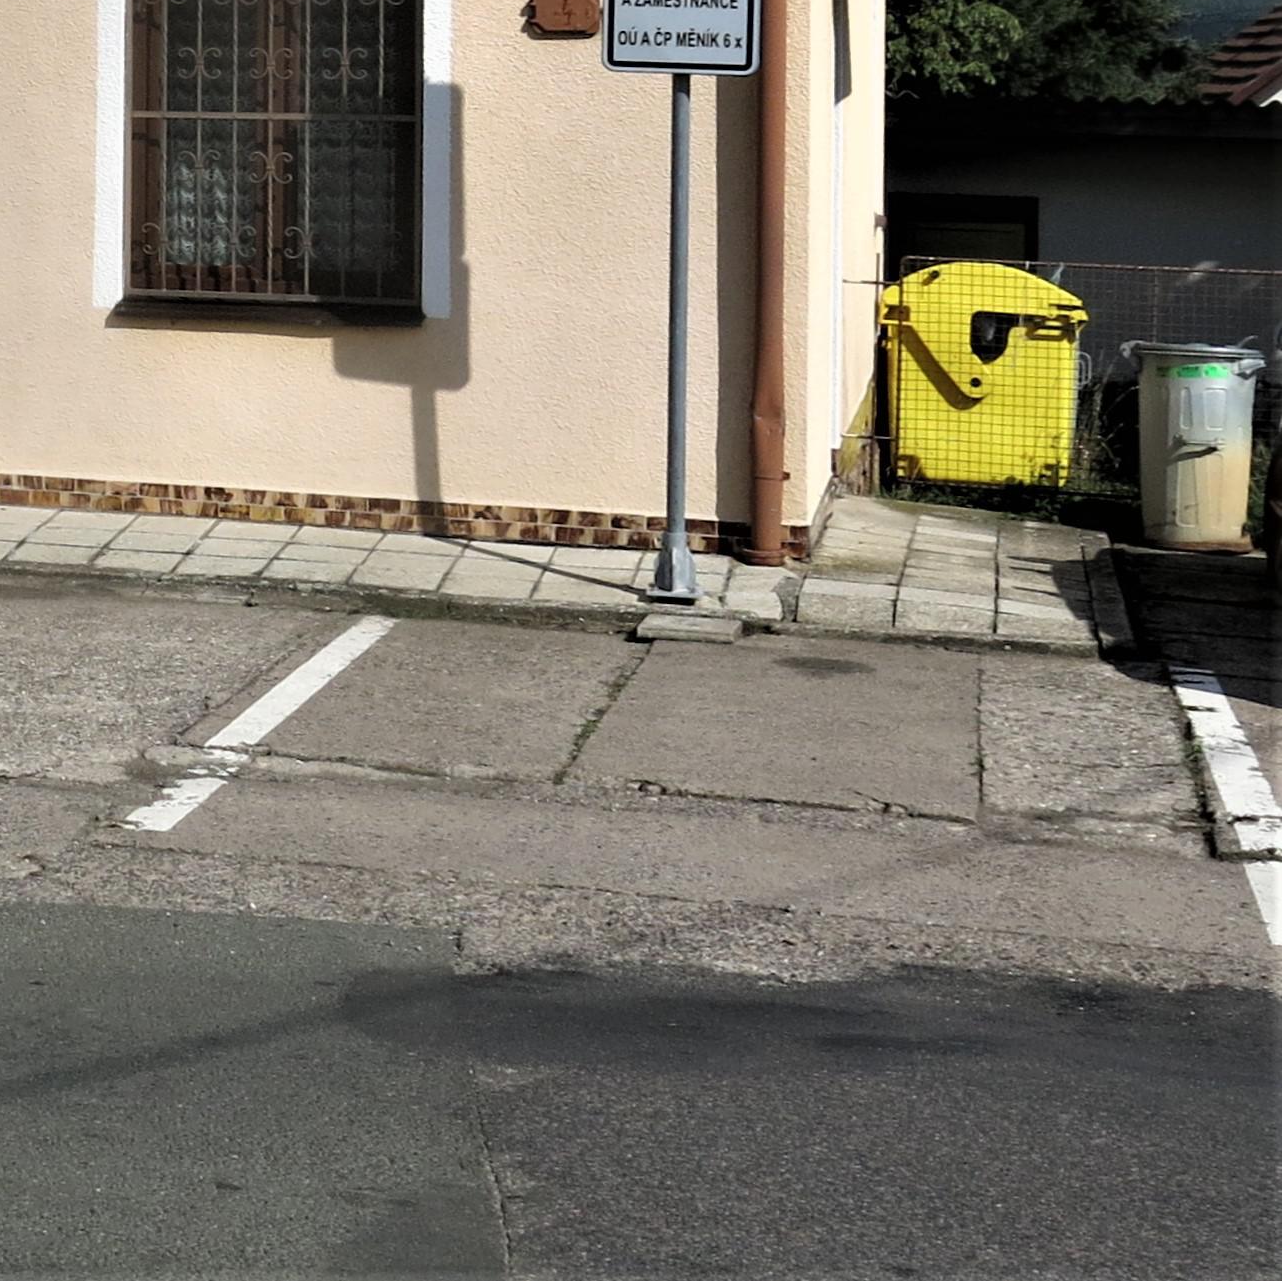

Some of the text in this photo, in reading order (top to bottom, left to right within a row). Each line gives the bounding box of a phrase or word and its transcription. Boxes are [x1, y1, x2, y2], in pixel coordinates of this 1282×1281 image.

[618, 26, 638, 46] OÚ
[640, 31, 651, 46] A
[654, 27, 672, 47] ČP
[676, 28, 720, 48] MĚNÍK
[723, 33, 732, 48] 6
